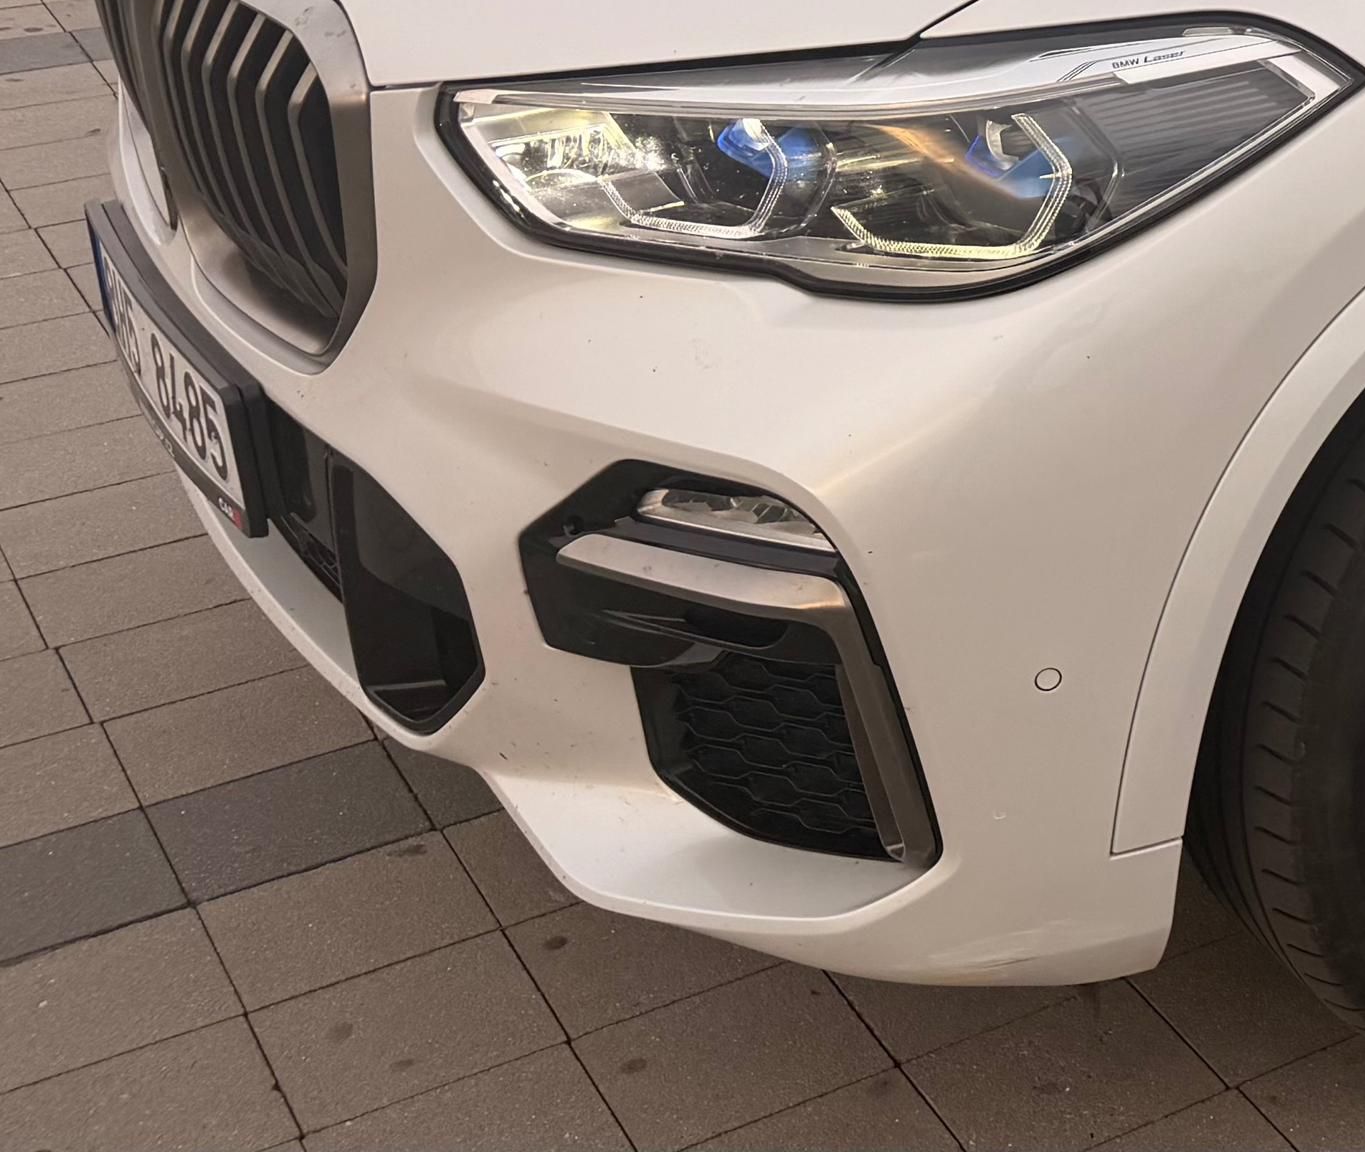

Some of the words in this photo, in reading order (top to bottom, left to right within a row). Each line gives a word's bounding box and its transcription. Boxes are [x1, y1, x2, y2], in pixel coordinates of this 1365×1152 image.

[1111, 58, 1140, 69] BMW
[1144, 51, 1184, 63] Laser
[151, 333, 229, 482] 8485
